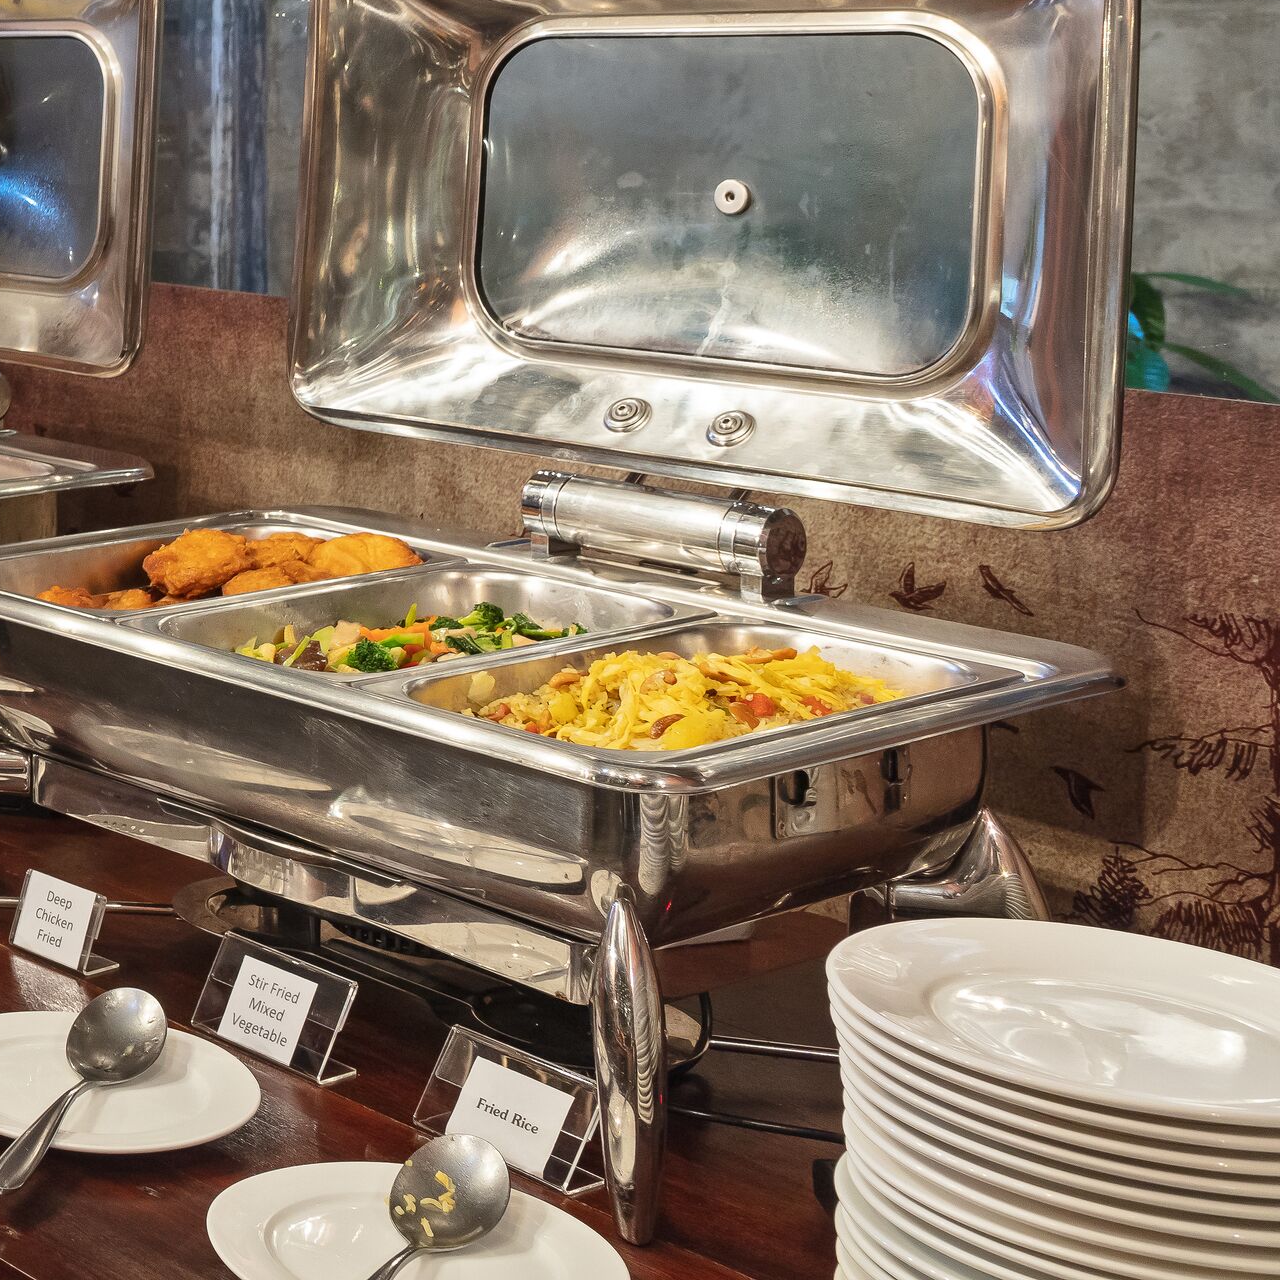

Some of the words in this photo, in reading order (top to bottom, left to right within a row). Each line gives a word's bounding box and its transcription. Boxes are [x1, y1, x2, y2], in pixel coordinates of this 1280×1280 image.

[46, 890, 73, 911] Deep
[35, 907, 74, 931] Chicken
[36, 928, 63, 948] Fried
[248, 974, 268, 992] Stir
[269, 982, 301, 1004] Fried
[248, 997, 286, 1022] Mixed
[231, 1012, 288, 1047] Vegetable
[475, 1097, 510, 1121] Fried
[510, 1112, 539, 1134] Rice
